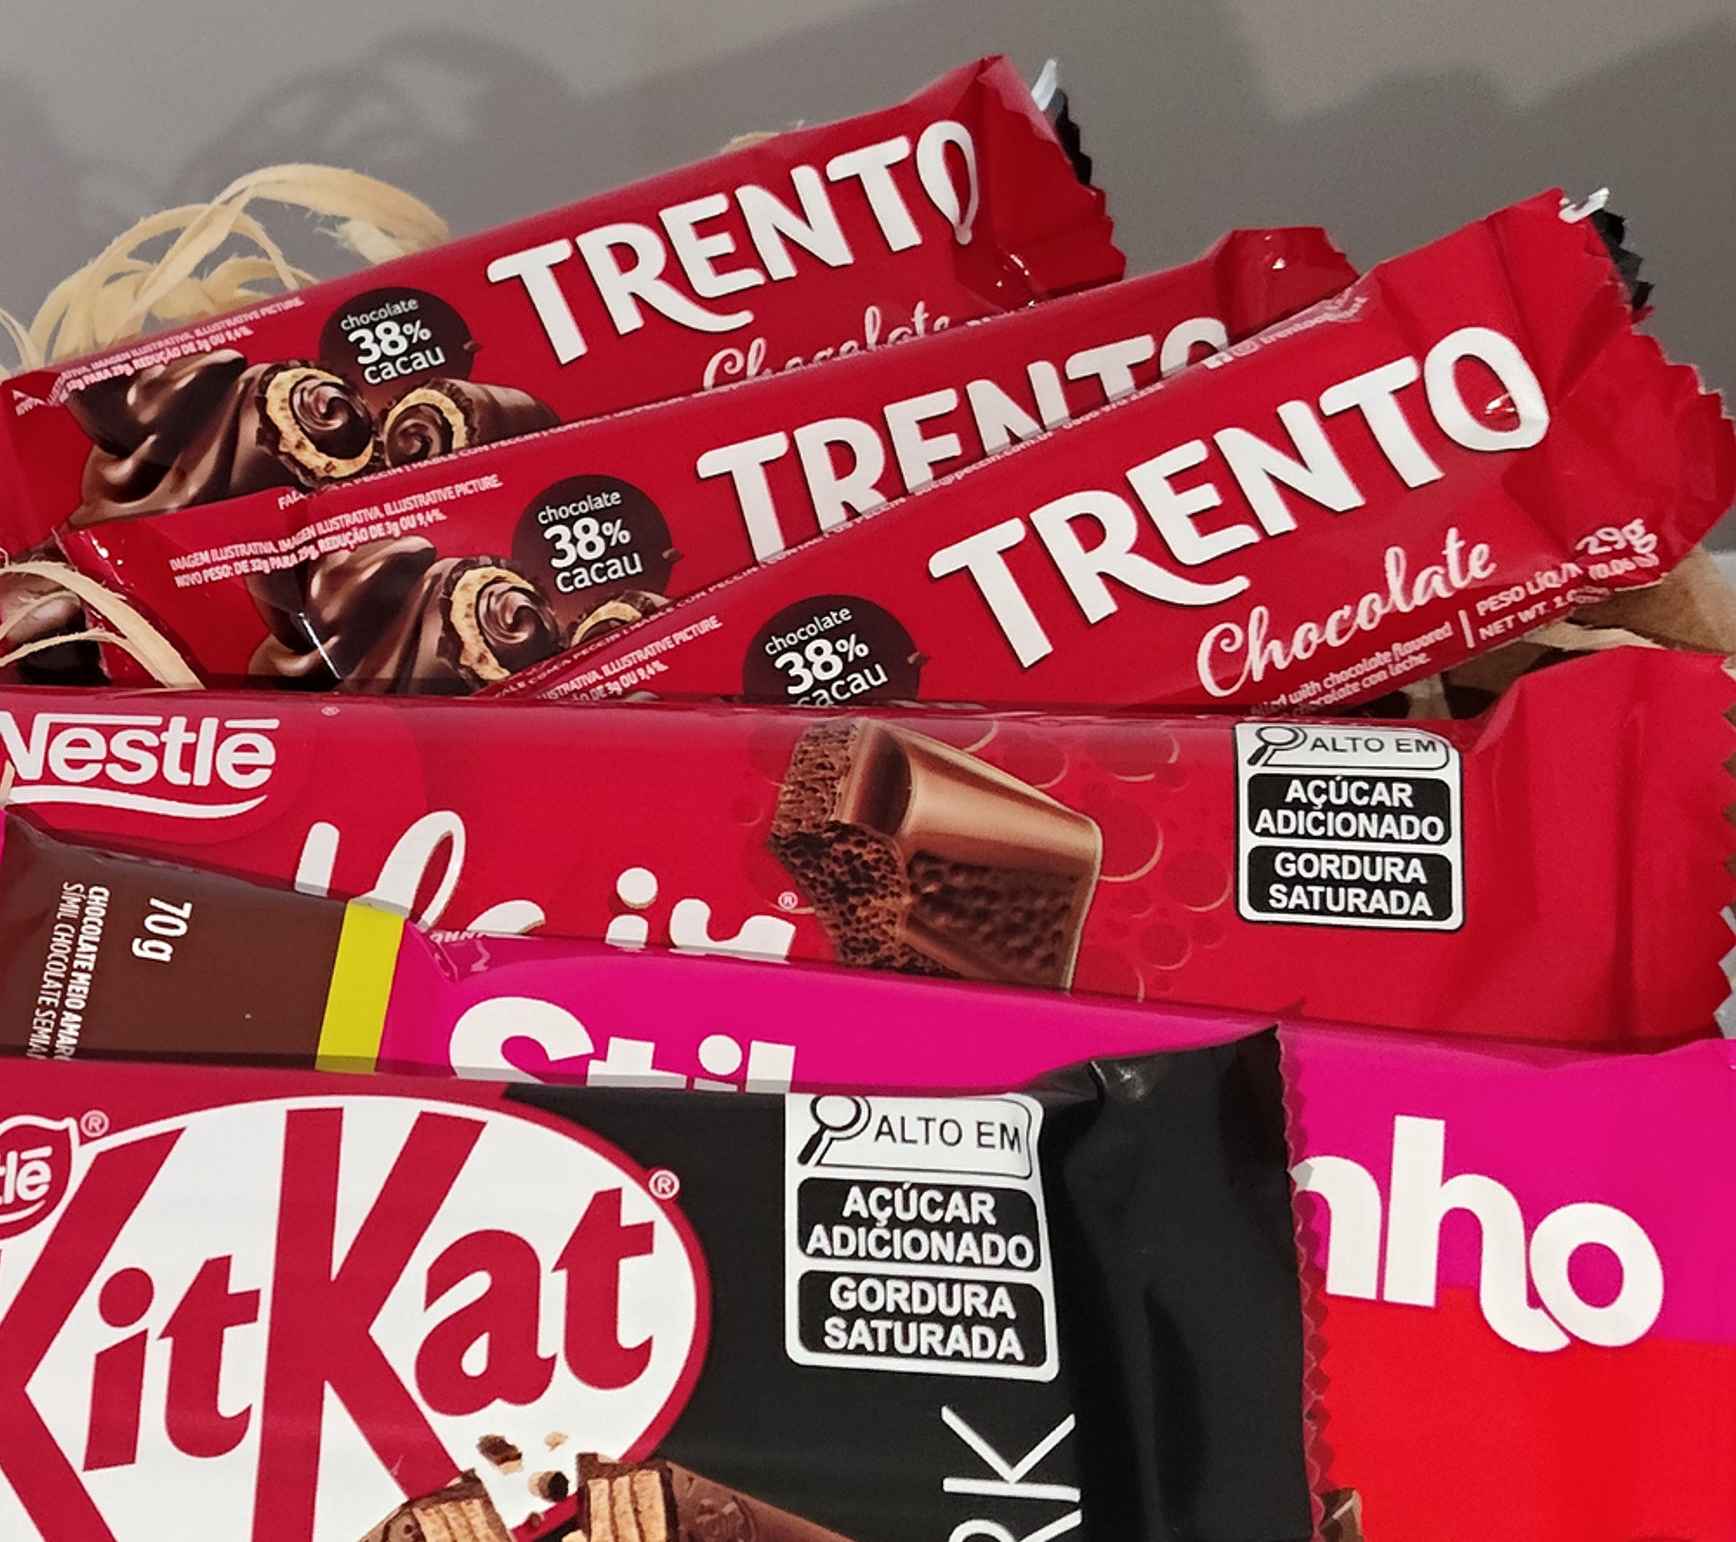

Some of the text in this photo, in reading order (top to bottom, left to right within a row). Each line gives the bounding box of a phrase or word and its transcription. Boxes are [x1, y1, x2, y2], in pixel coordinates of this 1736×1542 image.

[487, 120, 981, 365] TRENTO
[341, 297, 420, 333] chocolate
[348, 321, 432, 367] 38%
[363, 345, 446, 387] cacau
[537, 489, 622, 526] chocolate
[928, 326, 1550, 670] TRENTO
[318, 525, 369, 555] REDUÇÃO
[369, 523, 386, 540] DE
[400, 515, 417, 532] OU
[543, 516, 632, 571] 38%
[1575, 518, 1658, 555] 29g
[555, 552, 644, 595] cacau
[1195, 526, 1497, 700] Chocolate
[1476, 585, 1526, 616] PESO
[765, 607, 852, 656] chocolate
[1479, 614, 1515, 641] NET
[774, 633, 870, 695] 38%
[1310, 736, 1438, 754] ALTO EM
[1284, 775, 1414, 810] AÇÚCAR
[1254, 809, 1445, 842] ADICIONADO
[1274, 852, 1428, 885] GORDURA
[56, 880, 86, 920] SÍMIL
[1269, 883, 1434, 917] SATURADA
[72, 884, 110, 972] CHOCOLATE
[131, 897, 192, 963] 70 g
[38, 922, 76, 1008] CHOCOLATE
[64, 971, 93, 1011] MEIO
[874, 1114, 1022, 1154] ALTO EM
[842, 1181, 997, 1227] AÇÚCAR
[806, 1224, 1035, 1269] ADICIONADO
[829, 1275, 1016, 1320] GORDURA
[824, 1316, 1025, 1361] SATURADA
